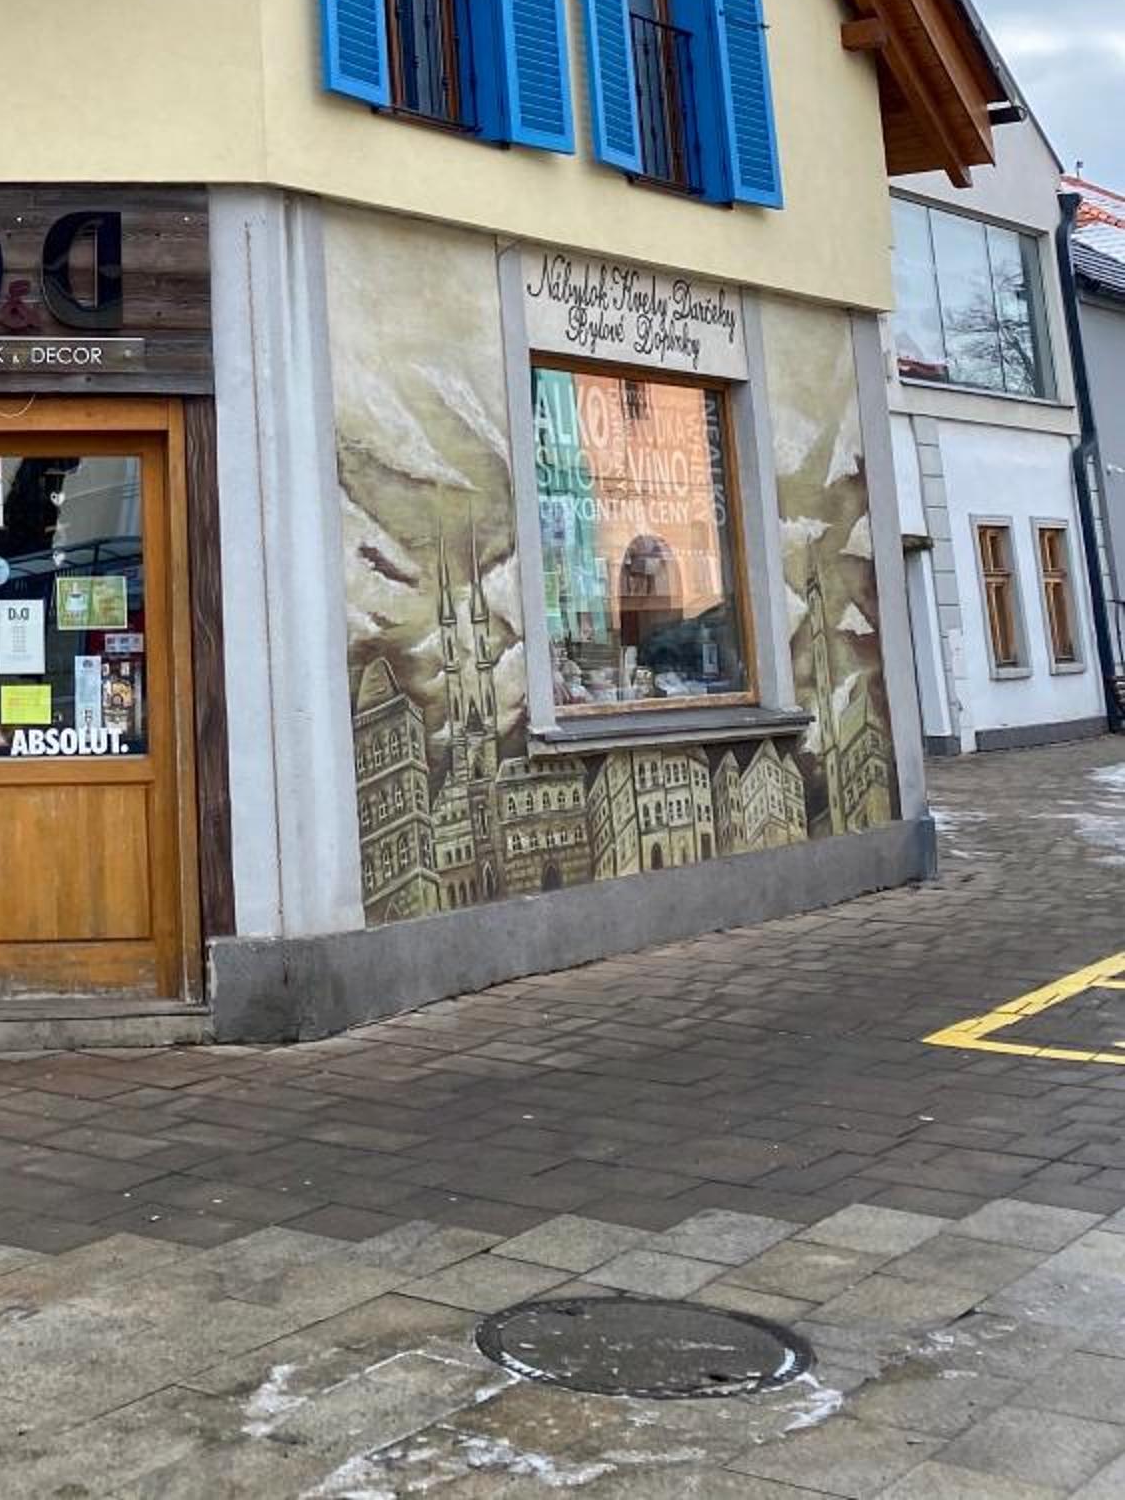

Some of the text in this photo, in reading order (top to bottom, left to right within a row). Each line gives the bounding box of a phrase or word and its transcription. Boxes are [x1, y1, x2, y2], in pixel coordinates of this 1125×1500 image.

[31, 347, 102, 364] DECOR
[535, 381, 610, 447] ALKO
[10, 728, 129, 756] ABSOLUT.
